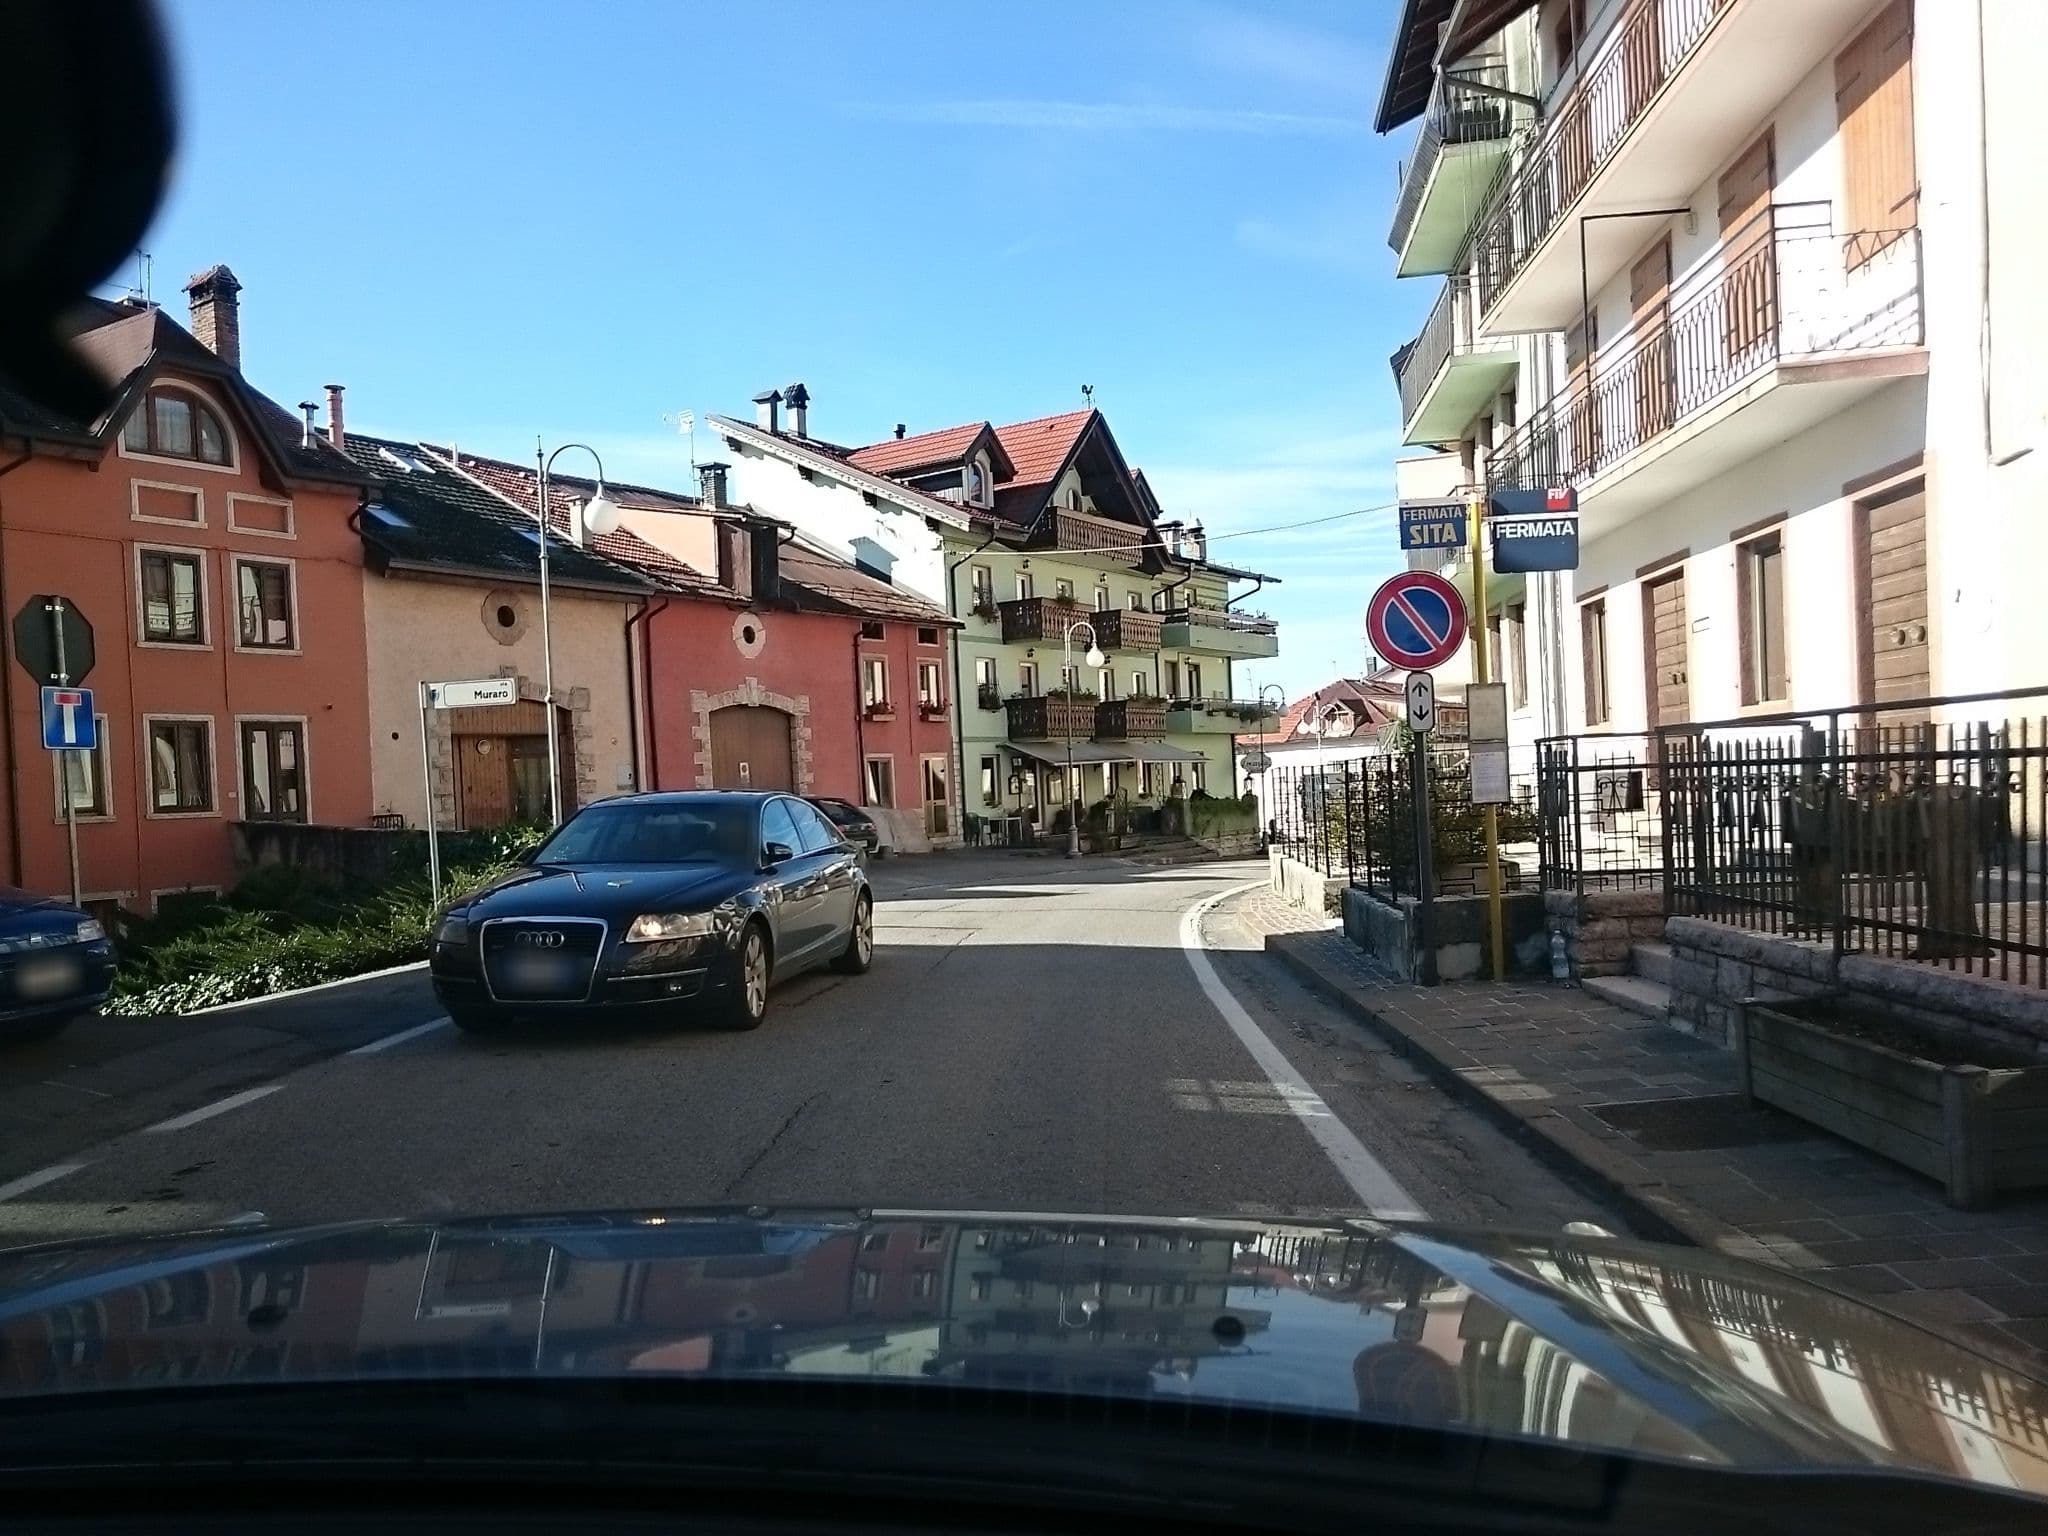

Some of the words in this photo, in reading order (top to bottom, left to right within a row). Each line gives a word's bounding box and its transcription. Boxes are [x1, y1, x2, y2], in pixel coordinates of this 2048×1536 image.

[1403, 507, 1462, 521] FERMATA
[1410, 523, 1457, 545] SITA
[1496, 521, 1575, 539] FERMATA
[474, 690, 508, 699] Muraro
